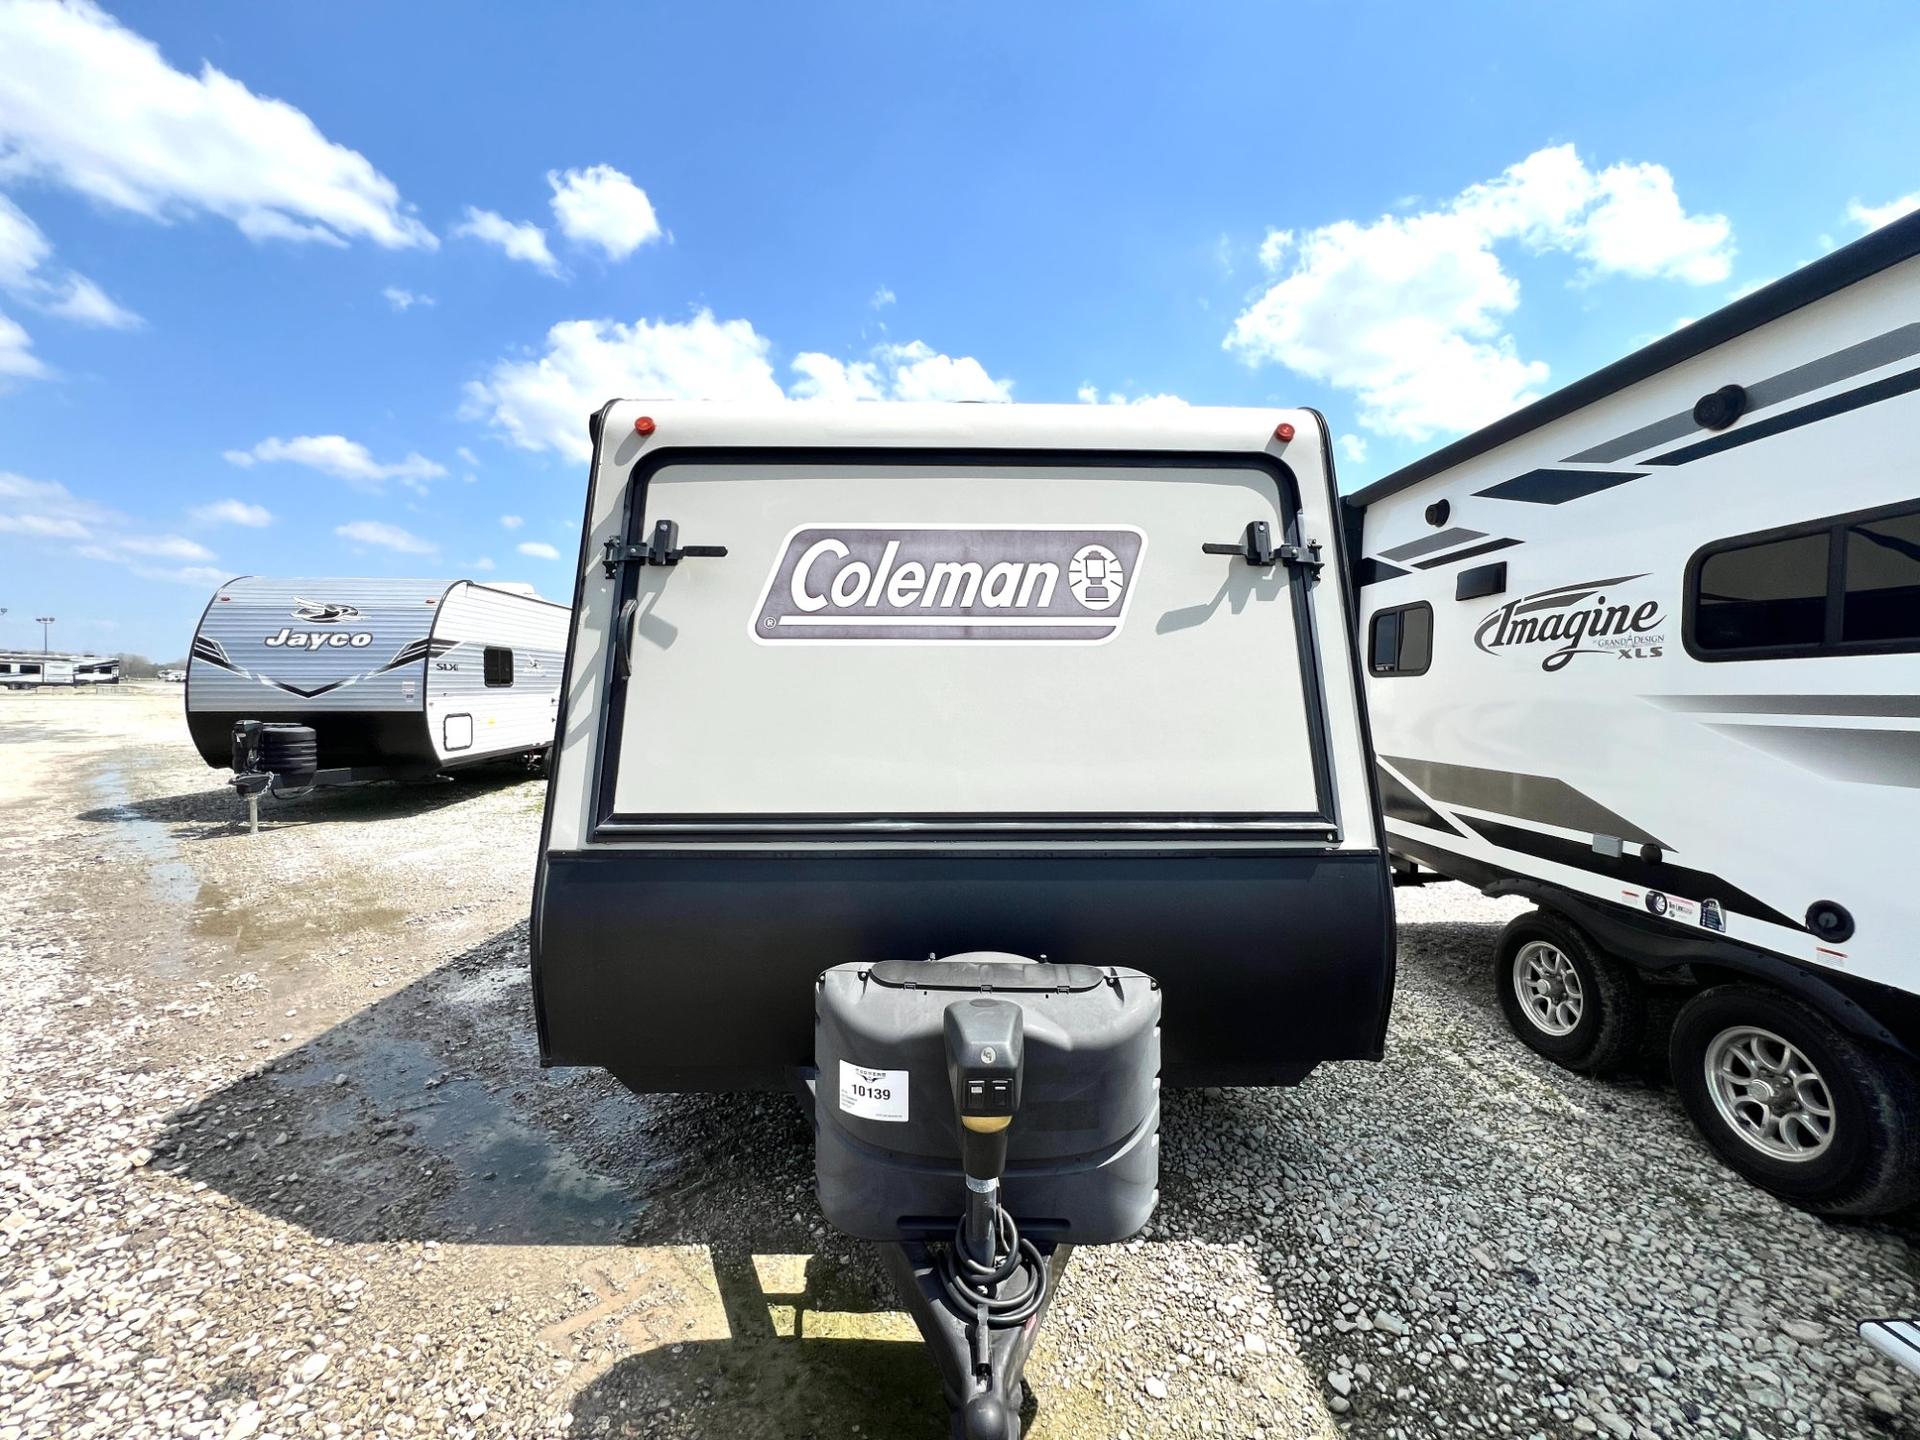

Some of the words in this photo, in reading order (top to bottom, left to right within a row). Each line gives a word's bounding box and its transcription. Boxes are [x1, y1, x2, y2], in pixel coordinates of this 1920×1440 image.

[791, 538, 1060, 612] Coleman
[265, 629, 373, 652] Jayco
[1488, 596, 1666, 672] Imagine
[1597, 637, 1627, 648] GRAND
[1633, 634, 1665, 645] DESIGN
[1618, 646, 1663, 660] XLS
[852, 1084, 891, 1101] 10139
